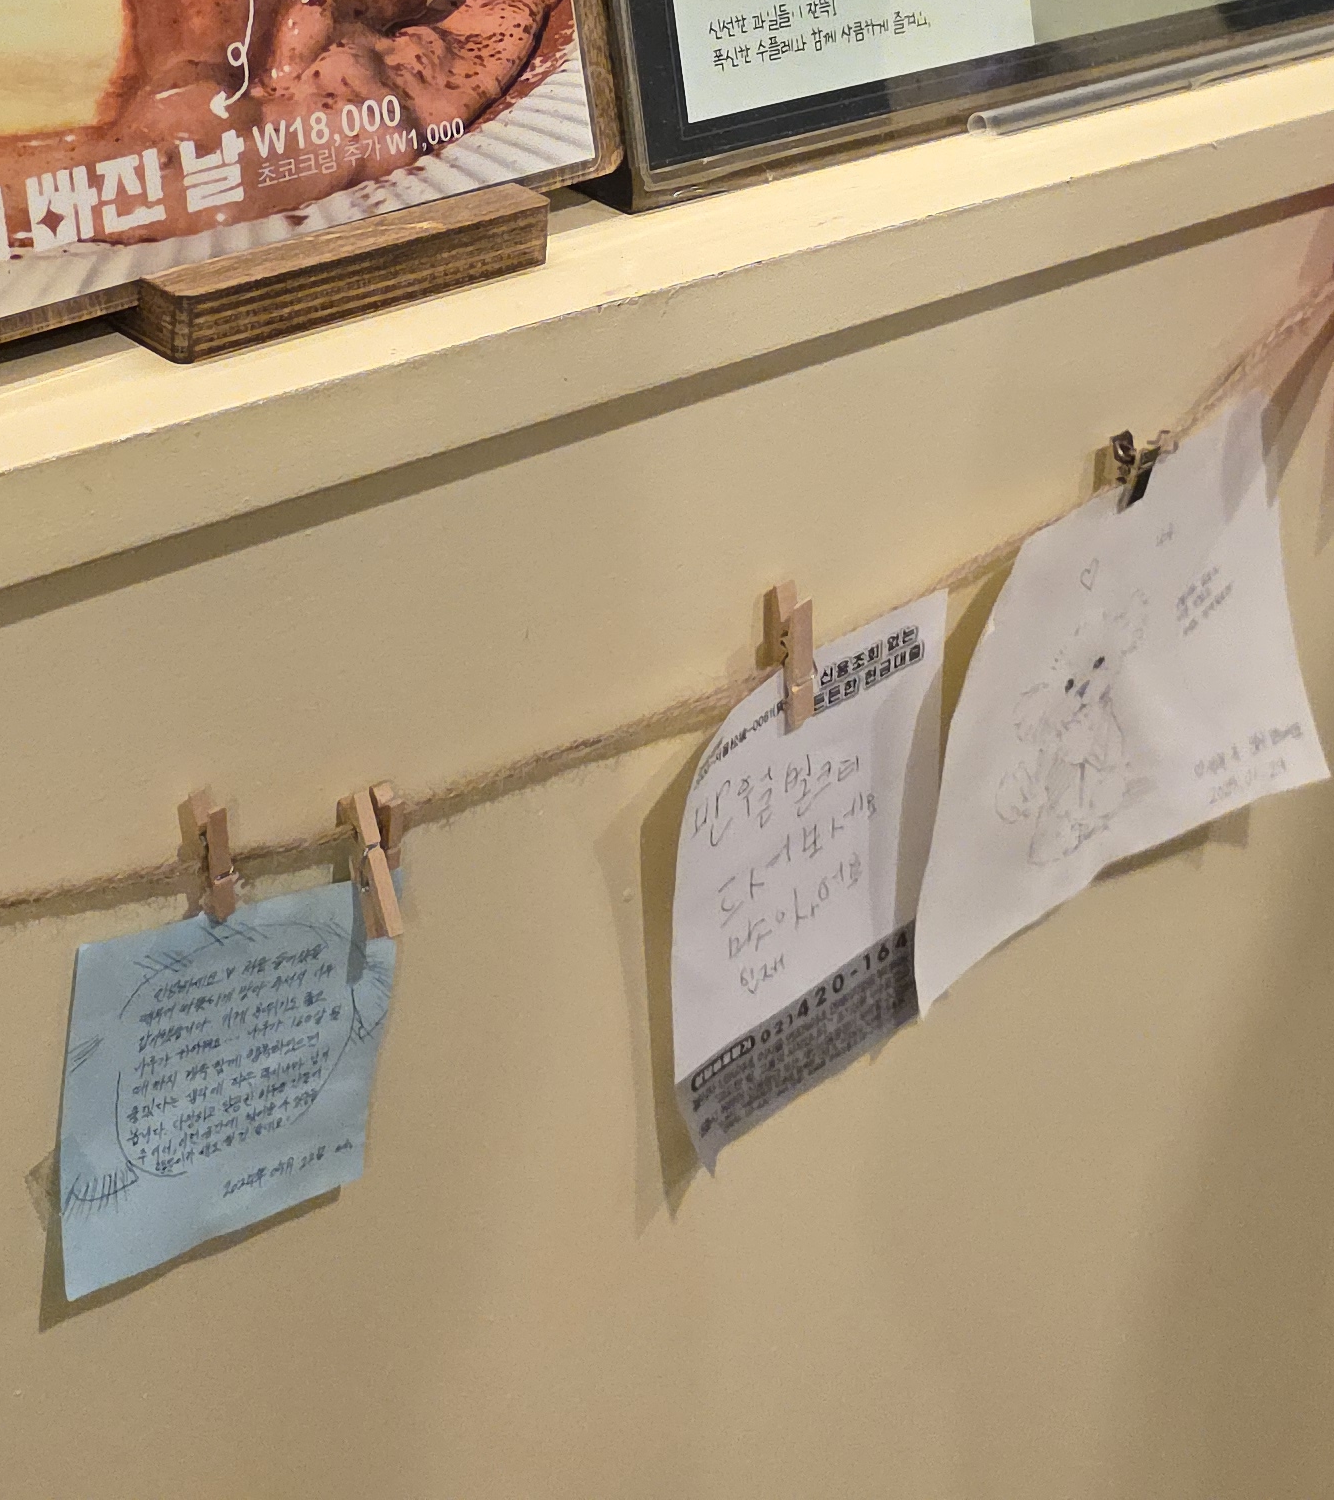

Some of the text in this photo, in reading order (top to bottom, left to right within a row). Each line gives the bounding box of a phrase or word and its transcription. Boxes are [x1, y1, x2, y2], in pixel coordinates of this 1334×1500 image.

[708, 15, 746, 40] 신선한
[752, 3, 803, 31] 과일들이
[712, 43, 751, 72] 폭신한
[756, 34, 807, 64] 수플레와
[811, 28, 837, 52] 함께
[252, 95, 401, 158] W18,000
[257, 117, 465, 188] 초코크림 추가 W1,000
[24, 146, 166, 251] 빠진
[180, 129, 248, 213] 날
[820, 624, 918, 685] 신용조회 없는
